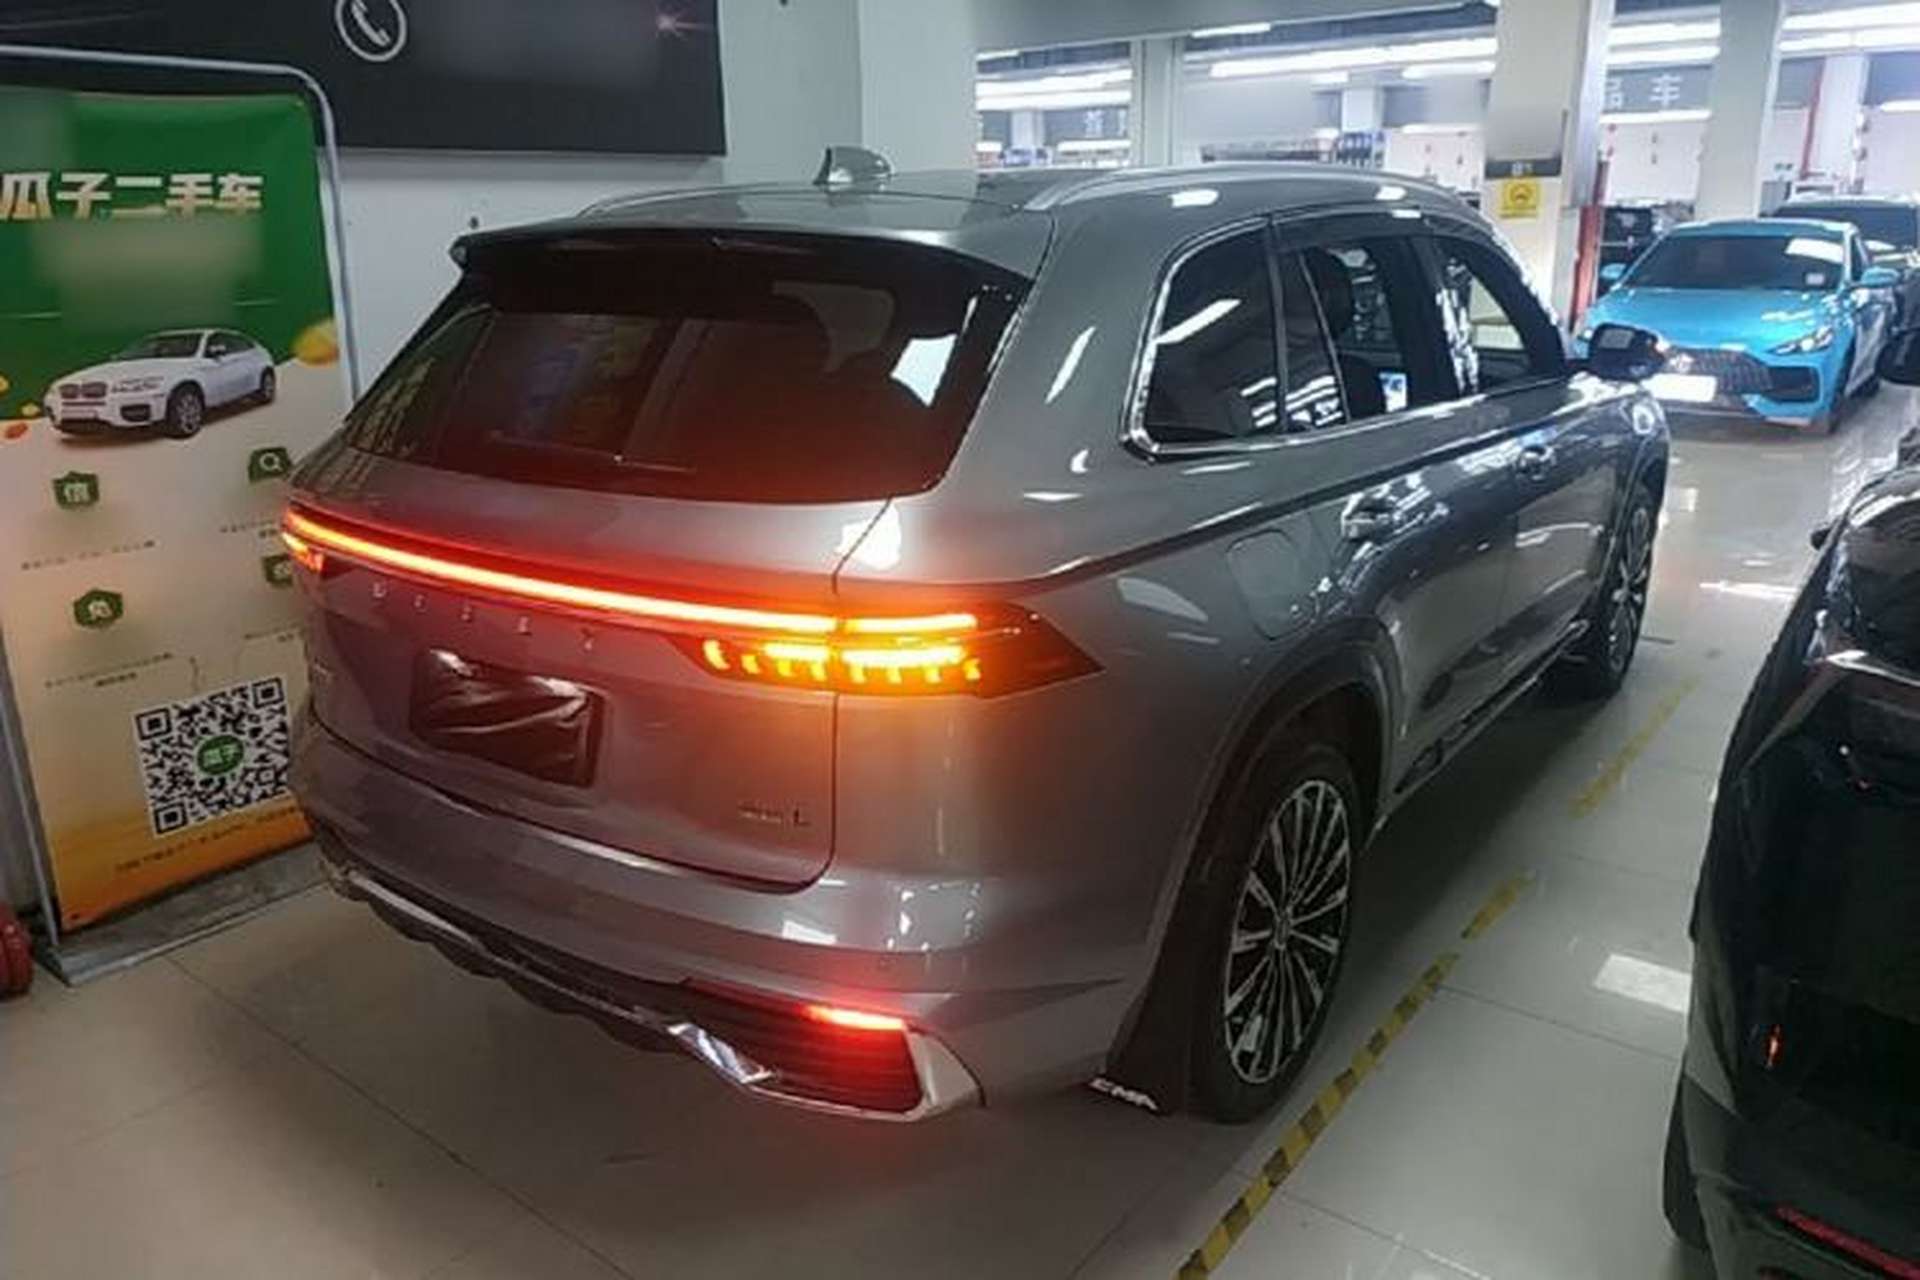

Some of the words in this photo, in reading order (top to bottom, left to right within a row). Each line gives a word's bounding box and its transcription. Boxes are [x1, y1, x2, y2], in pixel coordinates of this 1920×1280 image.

[0, 172, 263, 221] 瓜子二手车
